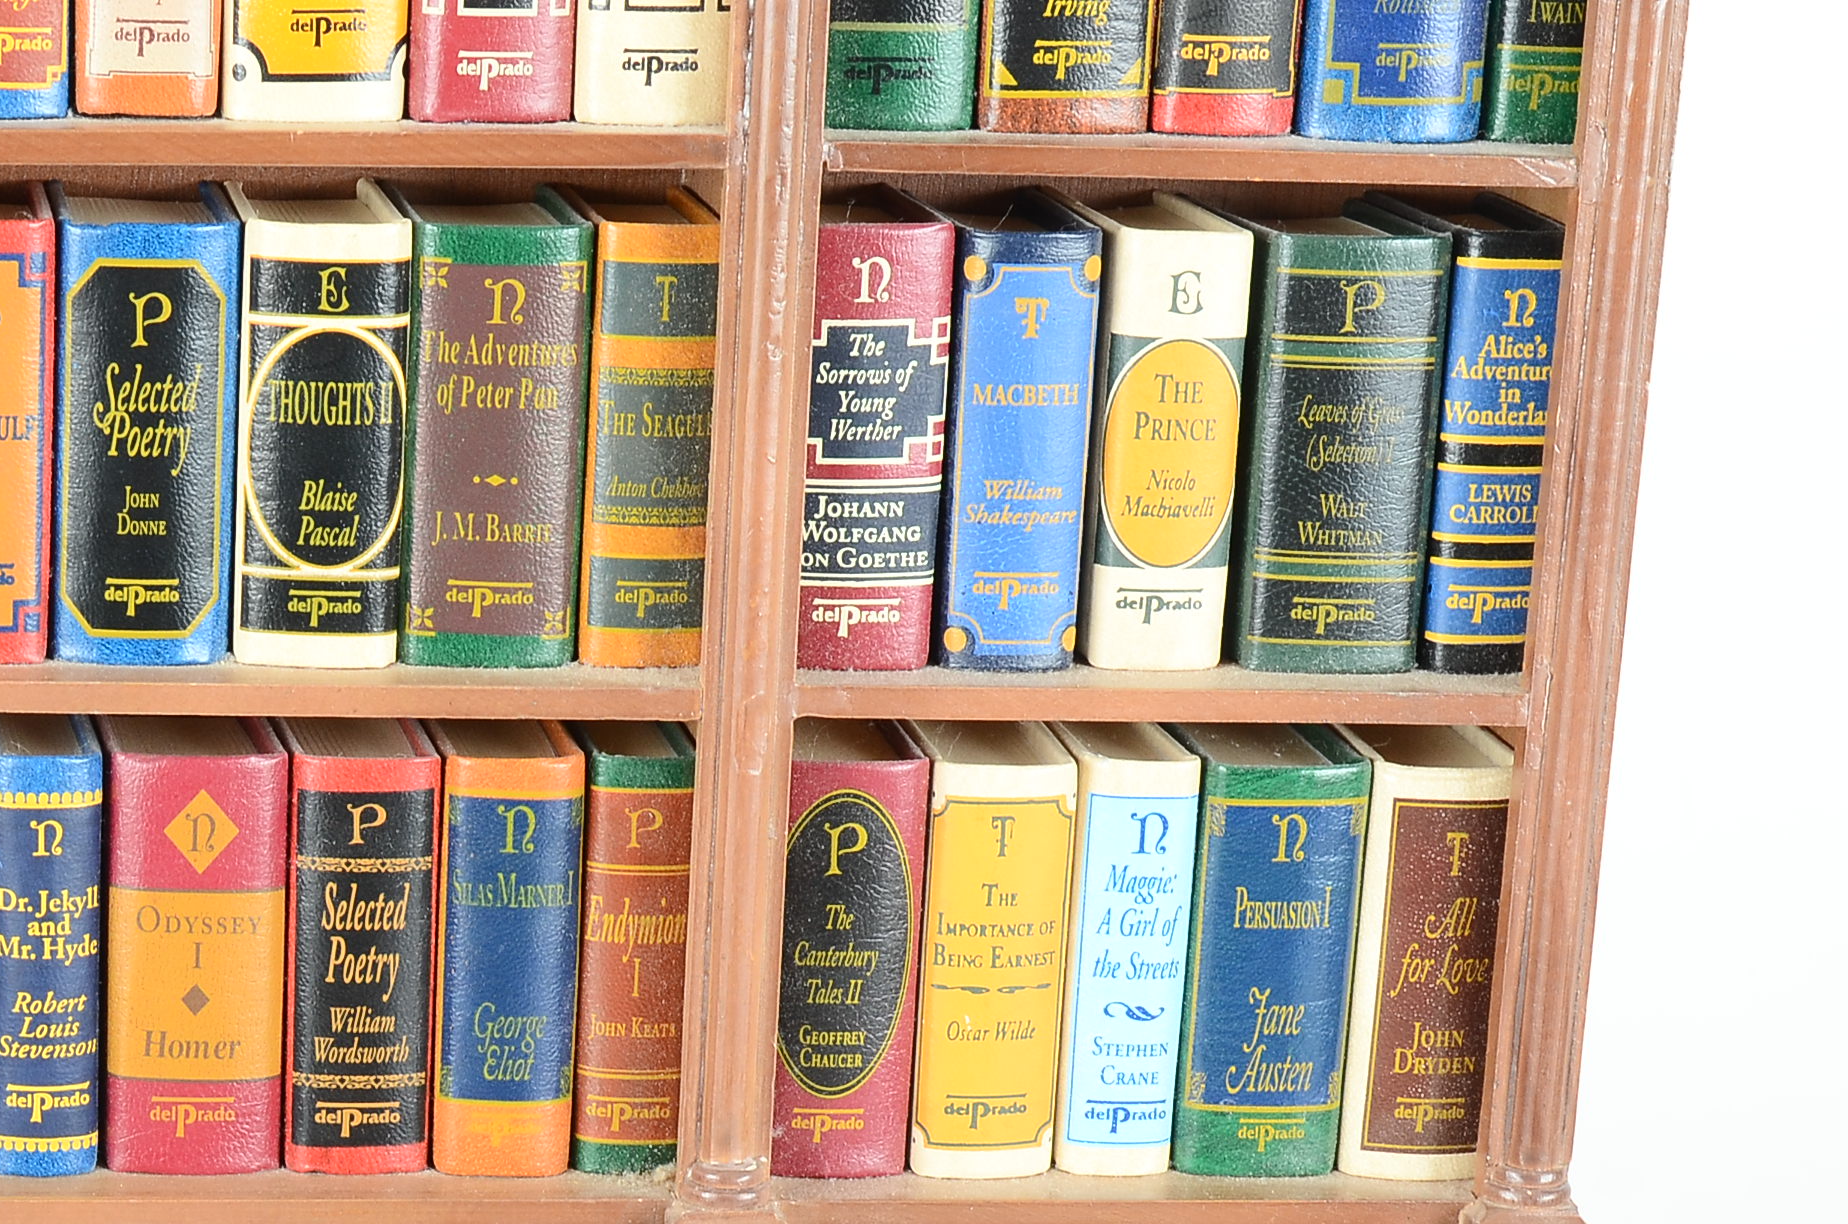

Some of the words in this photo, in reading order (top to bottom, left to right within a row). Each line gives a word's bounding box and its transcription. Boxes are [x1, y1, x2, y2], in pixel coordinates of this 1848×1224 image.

[849, 334, 885, 356] The
[1480, 337, 1547, 359] Alice's
[816, 364, 888, 385] Sorrows
[893, 362, 916, 390] of
[1154, 374, 1203, 405] THE
[93, 362, 202, 428] Selected
[268, 378, 376, 426] THOUGHTS
[380, 382, 394, 424] II
[838, 392, 896, 420] Young
[973, 383, 1079, 406] MACBETH
[829, 418, 902, 441] Werther
[102, 411, 191, 477] Poetry
[300, 480, 358, 511] Blaise
[983, 481, 1062, 501] William
[1469, 484, 1531, 504] LEWIS
[297, 515, 359, 547] Pascal
[963, 505, 1076, 532] Shakespeare
[36, 885, 99, 914] Jekyll
[321, 881, 411, 930] Selected
[983, 883, 1018, 907] THE
[28, 914, 72, 936] and
[826, 904, 854, 930] The
[1097, 907, 1114, 933] A
[1120, 906, 1156, 937] Girl
[1162, 905, 1179, 946] of
[42, 937, 98, 965] Hyde
[795, 941, 879, 976] Canterbury
[324, 934, 400, 1002] Poetry
[1093, 957, 1120, 981] the
[1125, 956, 1179, 981] Streets
[13, 992, 87, 1014] Robert
[807, 978, 844, 1004] Tales
[847, 978, 862, 1003] II
[20, 1016, 80, 1038] Louis
[329, 1007, 395, 1032] William
[474, 1002, 546, 1053] George
[946, 1021, 990, 1042] Oscar
[994, 1020, 1036, 1041] Wilde
[1245, 986, 1306, 1052] Jane
[143, 1030, 241, 1060] Homer
[314, 1035, 409, 1064] Wordsworth
[483, 1045, 535, 1081] Eliot
[1225, 1046, 1312, 1095] Austen
